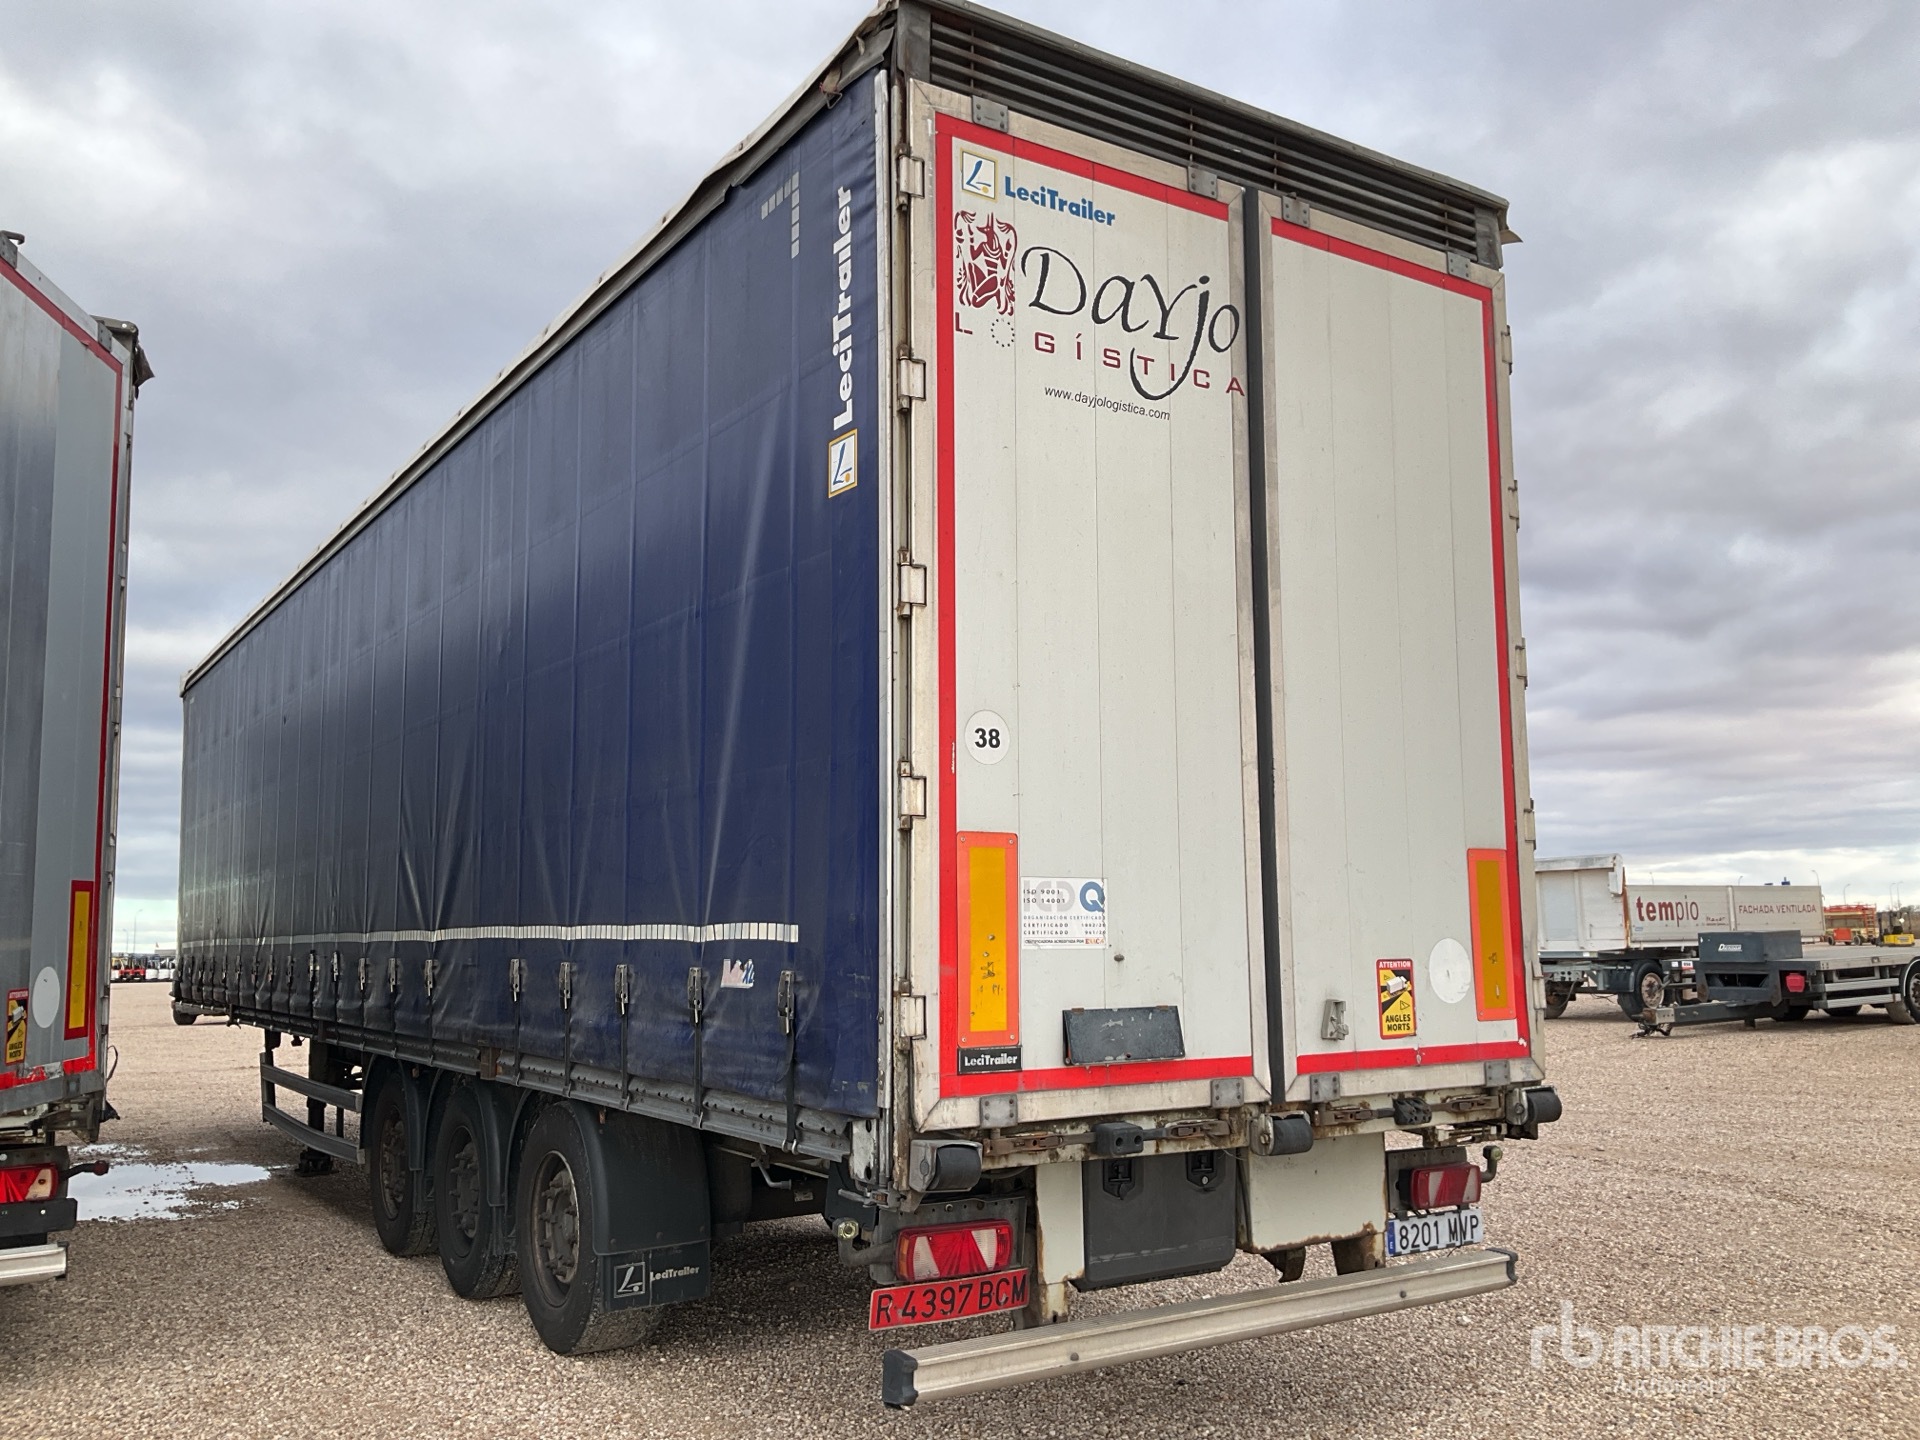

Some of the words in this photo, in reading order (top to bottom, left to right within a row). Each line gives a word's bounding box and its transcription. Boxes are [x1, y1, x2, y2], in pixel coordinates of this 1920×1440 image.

[1004, 175, 1116, 226] LeciTrailer
[833, 185, 853, 431] LeciTrailer
[1020, 245, 1240, 401] Dayjo
[1044, 386, 1171, 421] www.dayjologistica.com
[974, 727, 1001, 749] 38
[1636, 894, 1699, 928] tempio
[1738, 905, 1774, 914] FACHADA
[1776, 904, 1817, 914] VENTILADA
[1385, 1014, 1411, 1024] ANGLES
[1387, 1023, 1411, 1032] MORTS
[964, 1053, 1018, 1067] LeciTrailer
[1399, 1220, 1440, 1250] 8201
[1447, 1214, 1479, 1243] MVP
[650, 1264, 700, 1282] LeciTrailer
